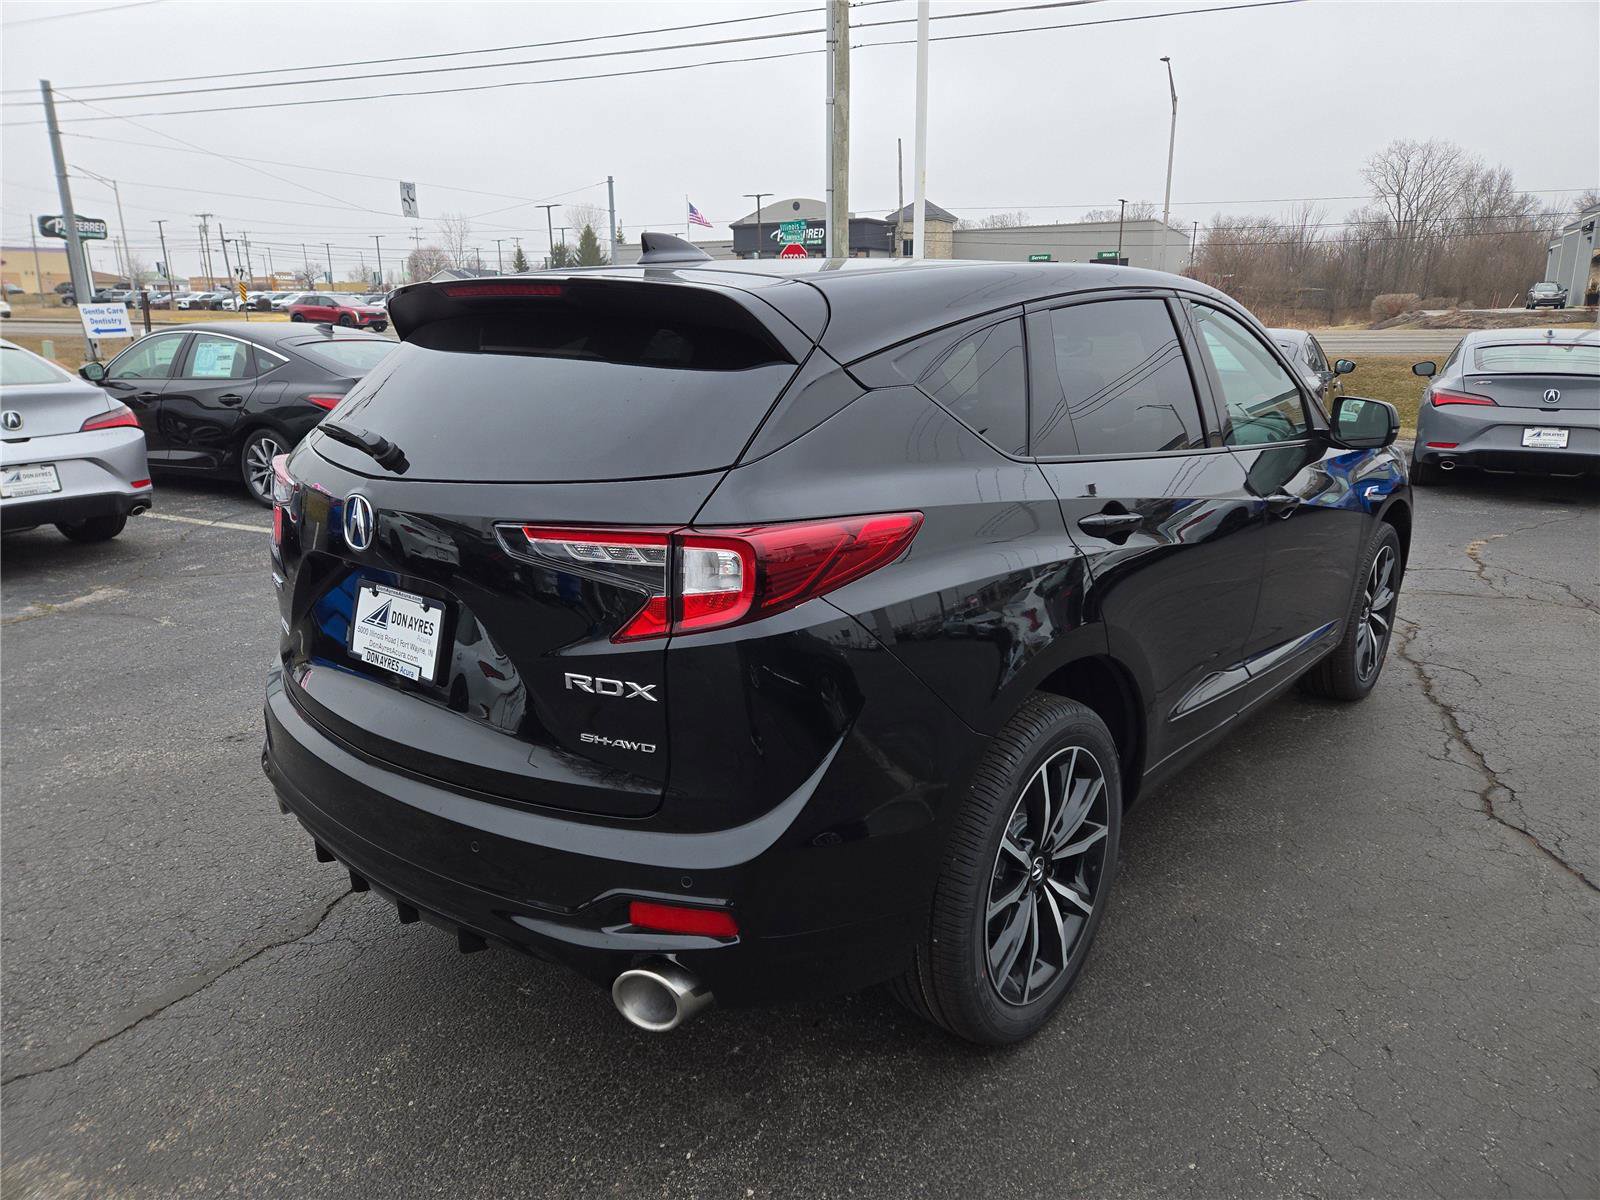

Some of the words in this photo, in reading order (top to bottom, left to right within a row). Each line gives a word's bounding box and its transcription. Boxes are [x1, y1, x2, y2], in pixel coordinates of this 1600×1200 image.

[82, 307, 105, 315] Gentle
[90, 317, 122, 325] Dentistry
[391, 611, 408, 628] DON
[407, 616, 434, 636] AYRES
[357, 625, 369, 636] 5000
[369, 630, 384, 641] Illinois
[385, 634, 397, 645] Road
[400, 640, 409, 650] Fort
[427, 649, 433, 657] IN
[369, 640, 419, 662] DonAyresAcura.com
[417, 635, 432, 645] Acura
[366, 651, 380, 663] DON
[379, 655, 400, 671] AYRES
[400, 666, 415, 678] Acura
[564, 672, 658, 702] RDX
[580, 733, 656, 753] SH-AWD
